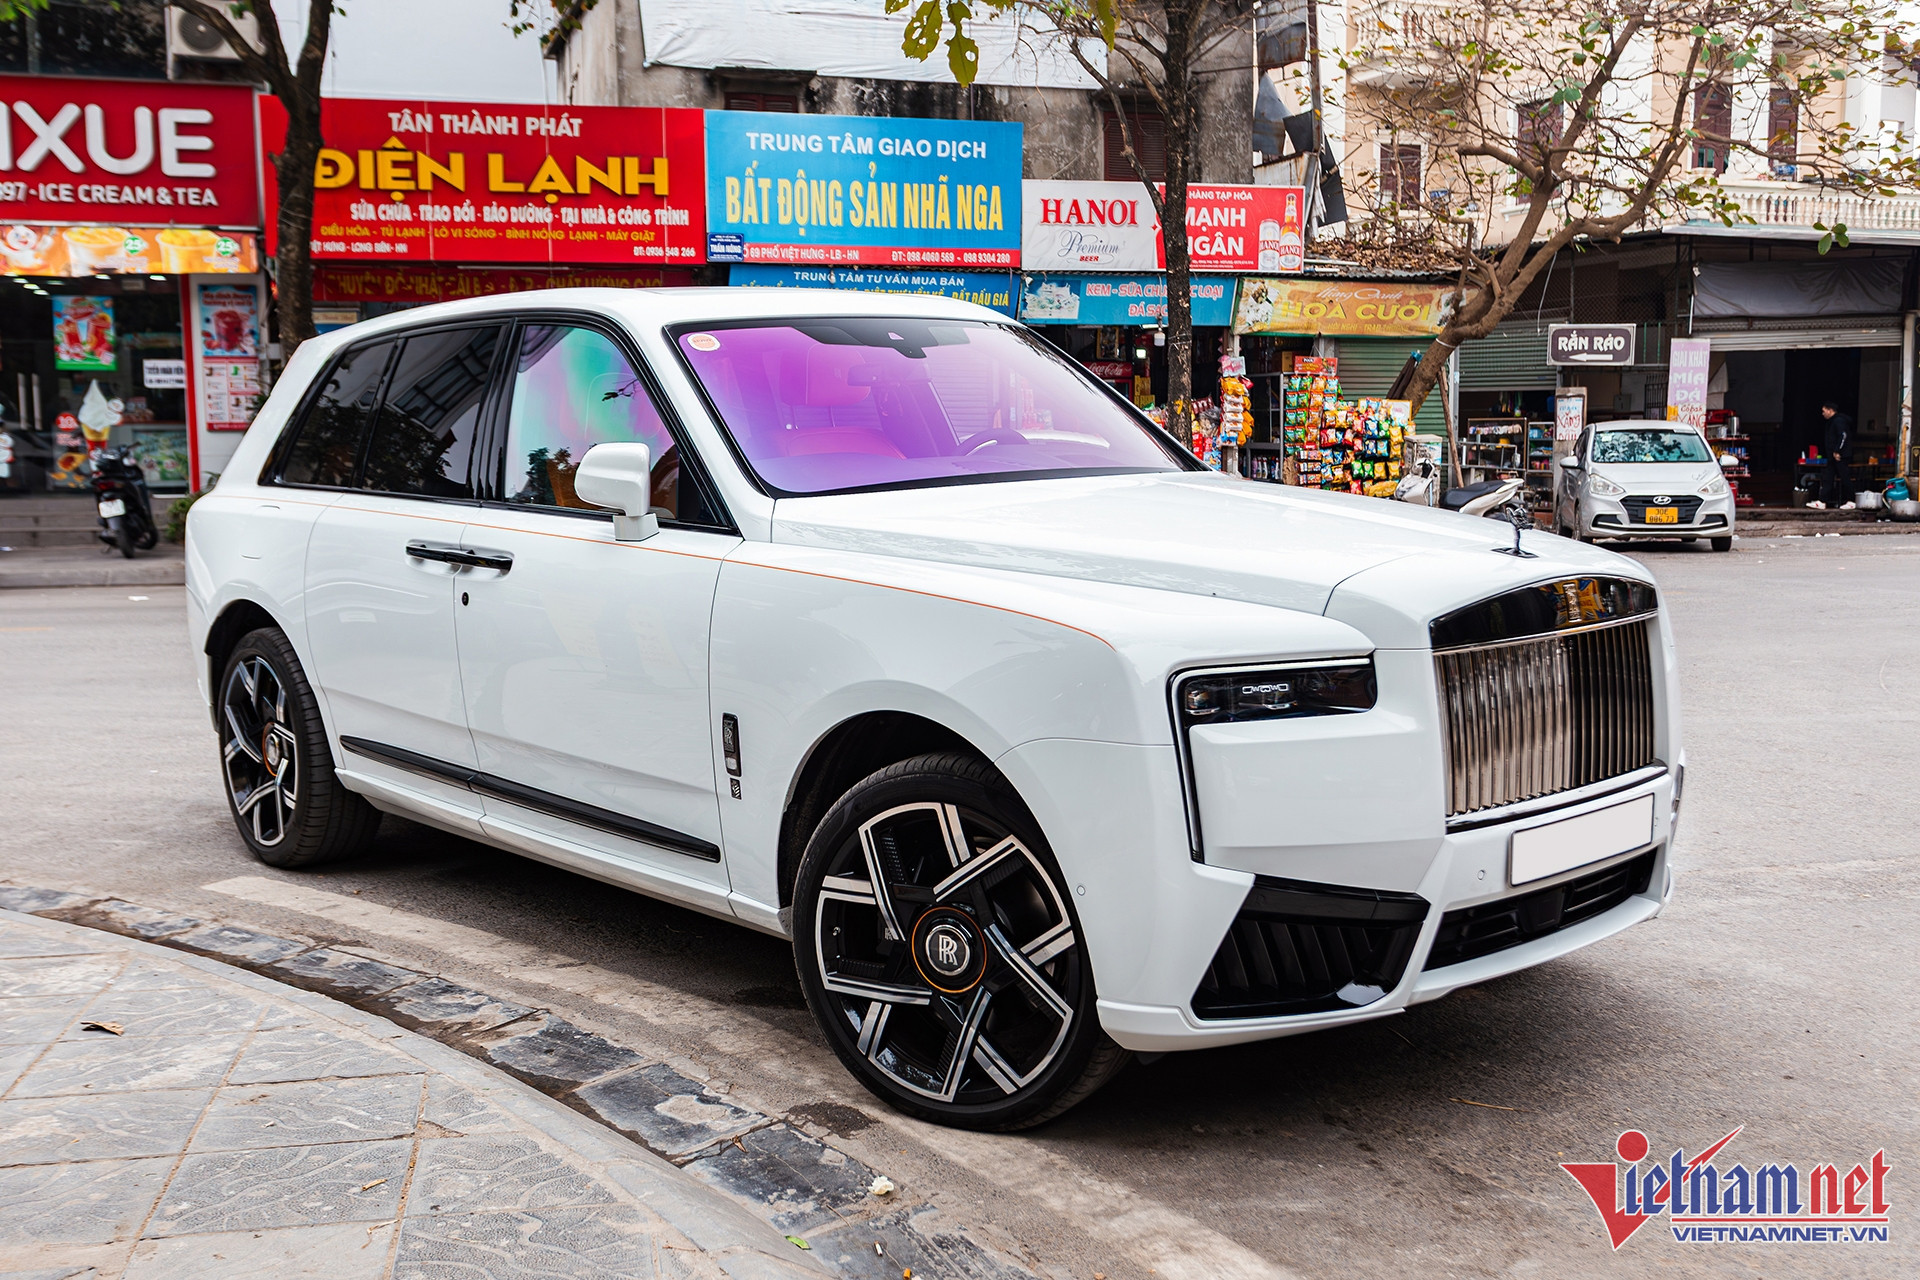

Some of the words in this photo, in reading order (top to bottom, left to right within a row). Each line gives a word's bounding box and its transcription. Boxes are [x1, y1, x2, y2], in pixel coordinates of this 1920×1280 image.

[388, 108, 433, 133] TÂN
[439, 109, 519, 136] THÀNH
[525, 112, 583, 137] PHÁT
[745, 132, 823, 153] TRUNG
[827, 132, 873, 155] TÂM
[878, 137, 932, 157] GIAO
[936, 140, 986, 162] DỊCH
[313, 135, 465, 202] ĐIỆN
[487, 153, 669, 204] LẠNH
[725, 160, 772, 225] BẤT
[777, 169, 843, 236] ĐỘNG
[849, 161, 898, 228] SẢN
[903, 174, 951, 229] NHÃ
[957, 184, 1004, 231] NGA
[1188, 189, 1215, 200] HÀNG
[1215, 191, 1233, 202] TẠP
[1233, 190, 1253, 200] HÓA
[350, 198, 377, 221] SỬA
[419, 204, 451, 222] TRAO
[453, 199, 475, 222] ĐỔI
[482, 201, 509, 223] BẢO
[560, 207, 579, 227] TẠI
[581, 204, 607, 225] NHÀ
[607, 208, 616, 225] &
[617, 205, 652, 225] CÔNG
[654, 205, 689, 226] TRÌNH
[1040, 198, 1139, 226] HANOI
[348, 224, 370, 237] HÒA
[380, 223, 394, 237] TỦ
[395, 227, 425, 240] LẠNH
[434, 225, 448, 238] LÒ
[451, 228, 461, 238] VI
[464, 226, 496, 239] SÓNG
[505, 227, 530, 239] BÌNH
[532, 227, 565, 240] NÓNG
[569, 230, 598, 242] LẠNH
[606, 229, 628, 241] MÁY
[630, 230, 655, 243] GIẶT
[351, 241, 373, 253] LONG
[374, 240, 391, 253] BIÊN
[395, 243, 408, 253] HN
[750, 248, 760, 259] 69
[761, 244, 780, 259] PHỐ
[780, 246, 800, 261] VIỆT
[800, 249, 824, 260] HƯNG
[830, 249, 841, 260] LB
[847, 250, 859, 261] HN
[1057, 229, 1120, 258] Premium
[891, 250, 906, 261] ĐT:
[838, 272, 864, 283] TÂM
[866, 274, 883, 284] TƯ
[885, 272, 909, 285] VẤN
[911, 276, 937, 285] MUA
[940, 276, 965, 286] BÁN
[992, 290, 1009, 306] GIÁ
[1086, 283, 1111, 296] KEM
[1118, 281, 1144, 297] SỮA
[1198, 285, 1224, 300] LOẠI
[1128, 301, 1146, 317] ĐÁ
[1355, 300, 1431, 321] CƯỚI
[1593, 333, 1625, 352] RÁO
[1672, 370, 1706, 385] MÍA
[1675, 387, 1701, 402] ĐÁ
